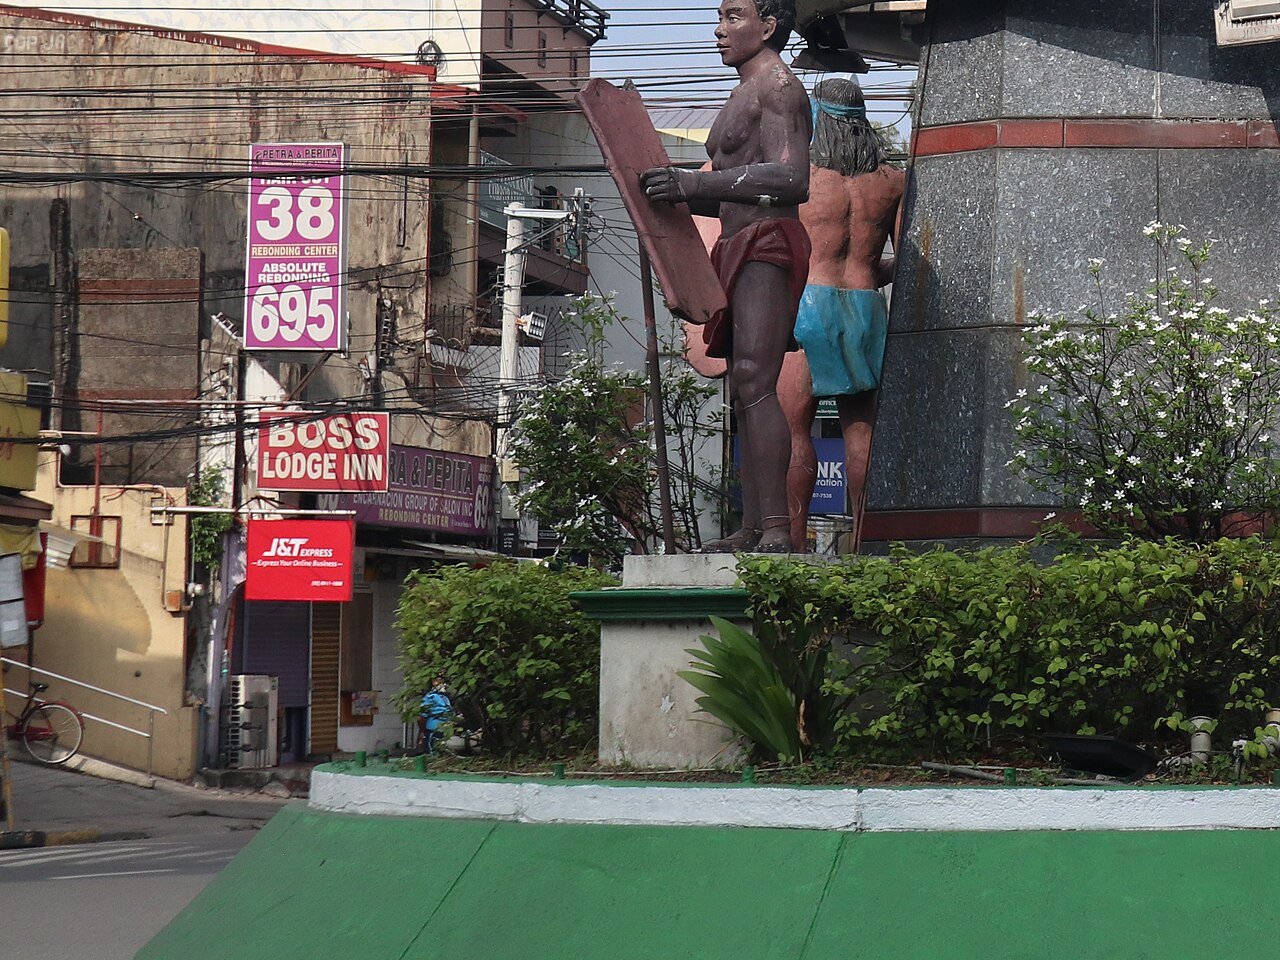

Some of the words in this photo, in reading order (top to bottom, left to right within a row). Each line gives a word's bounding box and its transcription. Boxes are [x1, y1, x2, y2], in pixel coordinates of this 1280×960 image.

[263, 149, 293, 159] PETRA
[305, 148, 338, 158] PEPITA
[256, 185, 335, 241] 38
[251, 246, 301, 256] REBONDING
[304, 246, 338, 256] CENTER
[257, 272, 331, 283] REBONDING
[262, 262, 327, 273] ABSOLUTE
[251, 284, 335, 342] 695
[269, 416, 380, 450] BOSS
[262, 451, 337, 480] LODGE
[343, 453, 383, 481] INN
[423, 453, 474, 496] PEPITA
[404, 494, 428, 511] GROUP
[429, 496, 439, 511] OF
[461, 501, 474, 517] INC
[379, 508, 420, 523] REBONDING
[422, 512, 449, 528] CENTER
[262, 537, 309, 557] J&T
[300, 548, 334, 558] EXPRESS
[257, 559, 279, 567] Express
[280, 559, 293, 567] Your
[293, 559, 312, 567] Online
[312, 559, 338, 568] Business
